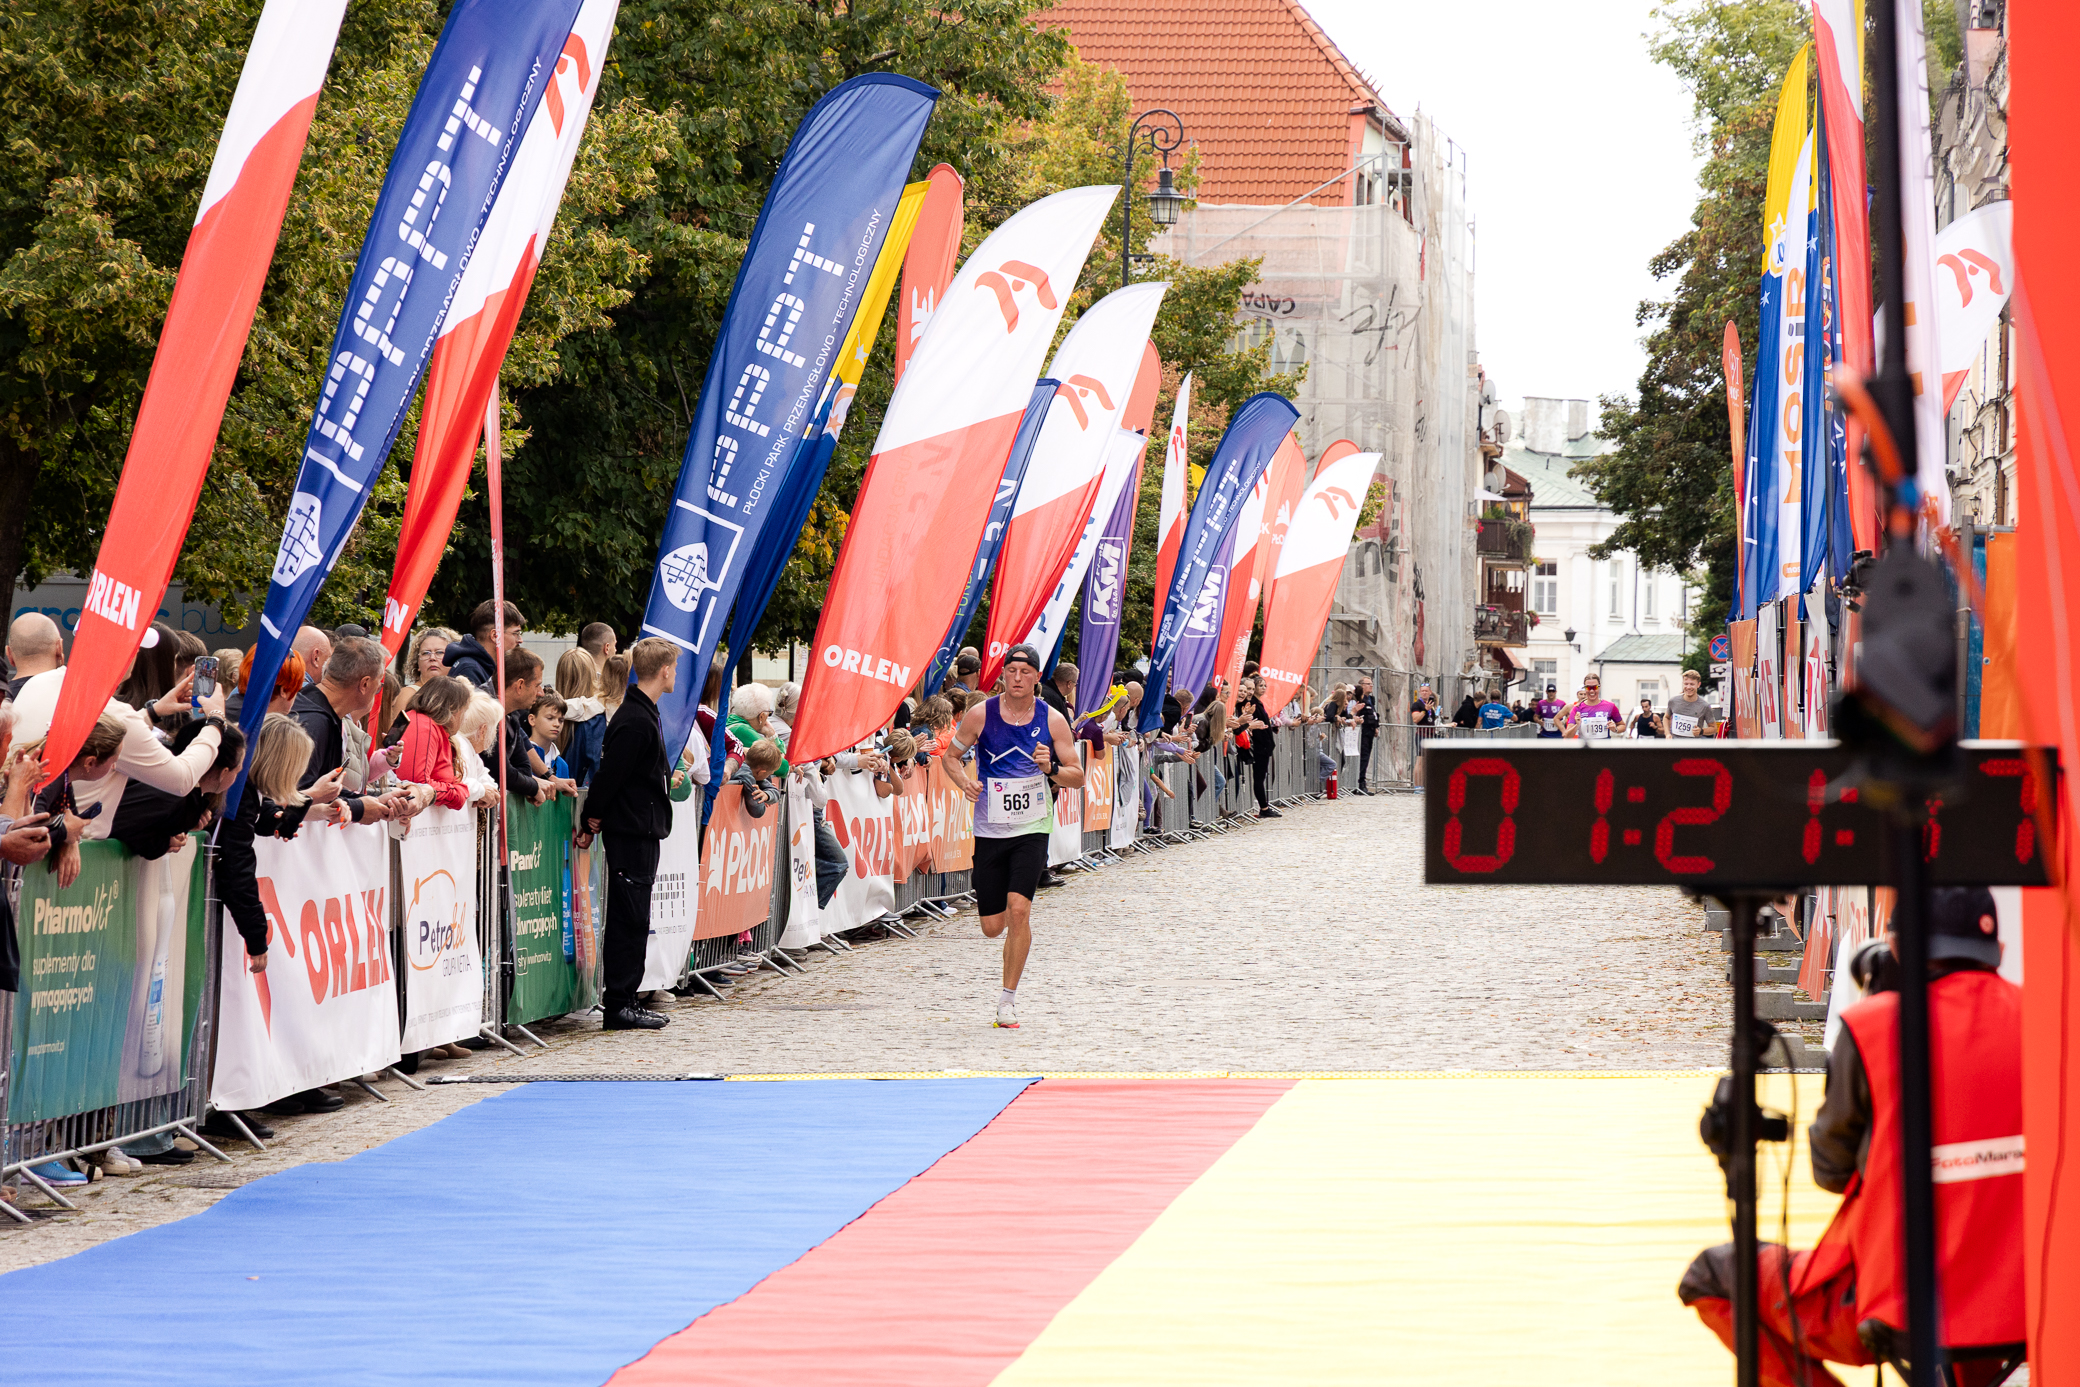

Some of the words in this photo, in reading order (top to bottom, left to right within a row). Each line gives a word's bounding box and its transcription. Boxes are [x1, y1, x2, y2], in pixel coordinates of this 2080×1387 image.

[480, 56, 542, 214] TECHNOLOGICZNY
[707, 222, 844, 508] PPPT
[742, 469, 771, 515] PŁOCKI
[764, 434, 790, 468] PARK
[783, 334, 835, 433] PRZEMYSŁOWO
[832, 208, 882, 325] TECHNOLOGICZNY
[1092, 542, 1121, 619] KM
[1187, 571, 1222, 633] KM
[823, 644, 911, 688] ORLEN
[1260, 666, 1303, 685] ORLEN
[1675, 722, 1691, 732] 1259
[1003, 792, 1030, 811] 563
[300, 887, 390, 1005] ORLEN
[419, 901, 466, 955] Petrotel
[32, 952, 81, 982] suplementy
[80, 950, 96, 971] dla
[31, 982, 94, 1015] wymagających
